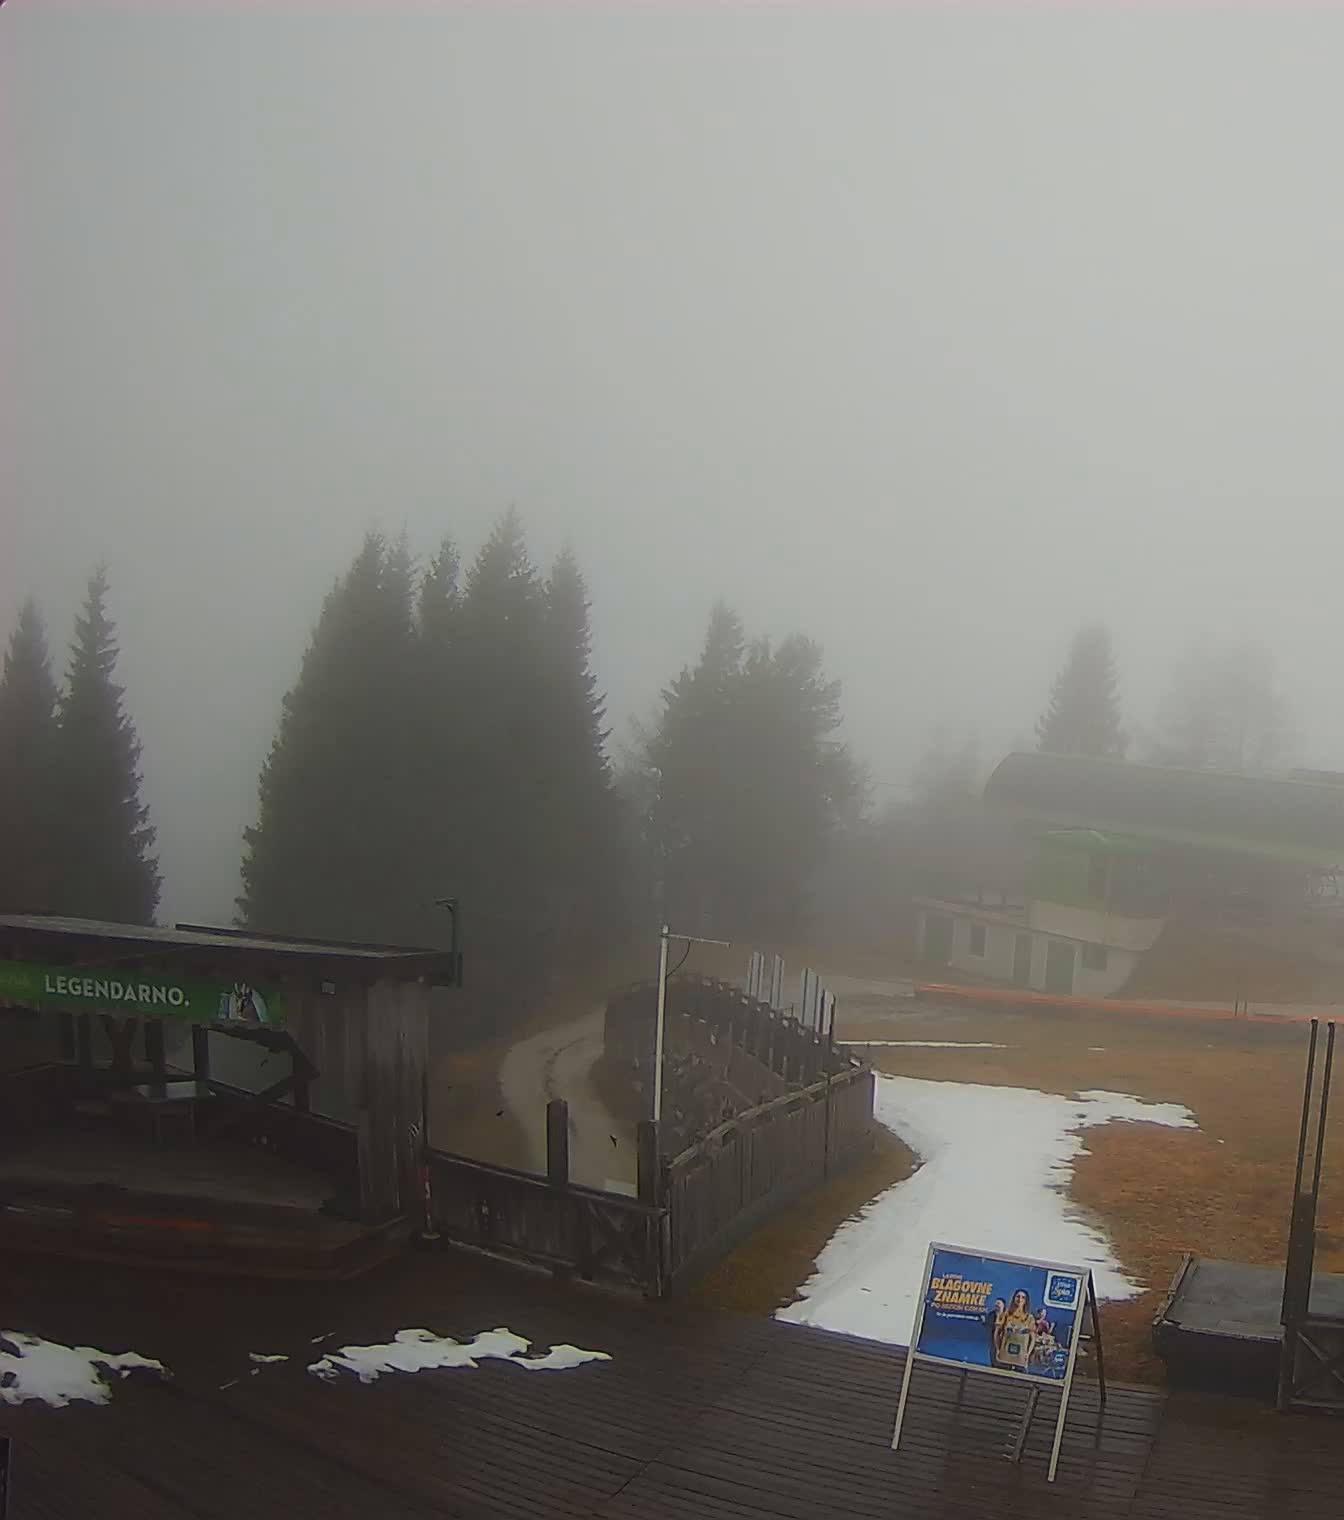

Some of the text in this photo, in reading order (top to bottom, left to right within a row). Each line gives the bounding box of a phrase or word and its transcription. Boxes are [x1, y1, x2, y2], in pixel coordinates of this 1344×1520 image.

[44, 974, 190, 1007] LEGENDARNO.
[930, 1277, 993, 1295] BLAGOVNE
[934, 1290, 987, 1306] ZNAMKE
